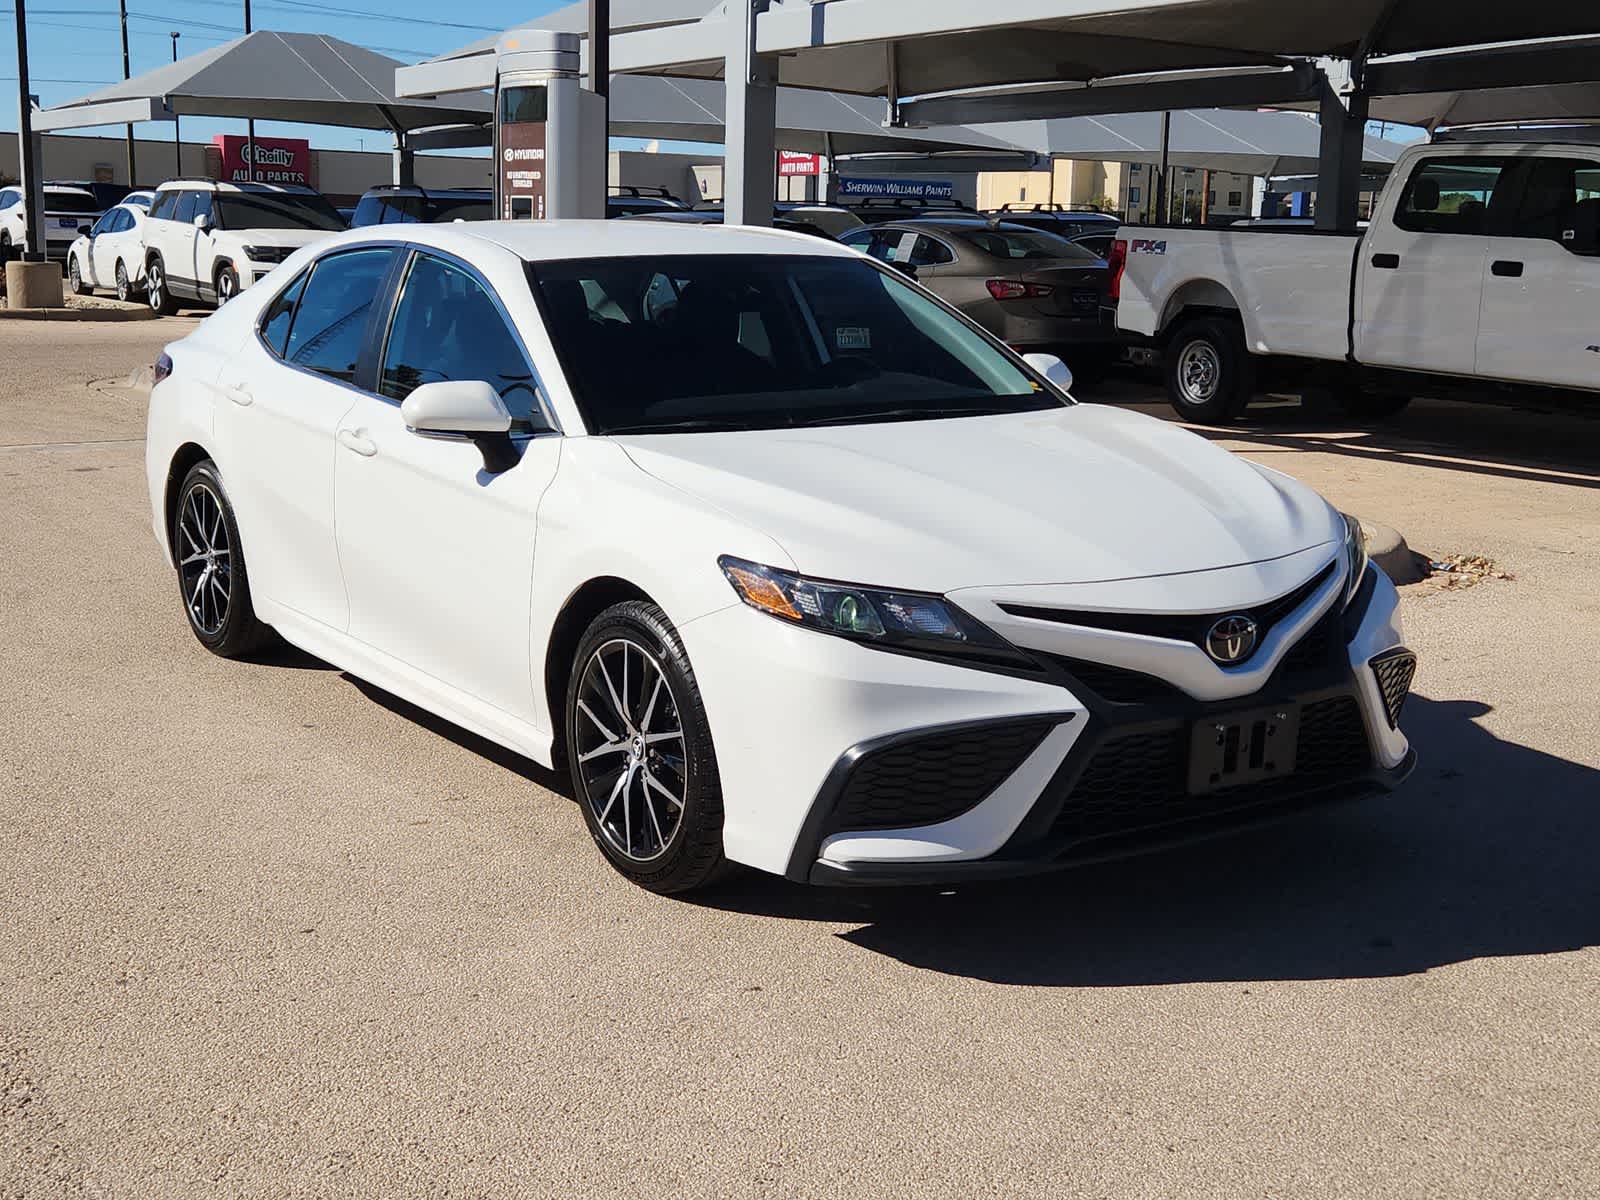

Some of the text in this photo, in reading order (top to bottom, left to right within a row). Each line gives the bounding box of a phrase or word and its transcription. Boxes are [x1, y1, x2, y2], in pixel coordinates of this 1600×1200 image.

[514, 149, 544, 160] HYUNDAI
[796, 162, 814, 173] PARTS
[232, 169, 304, 182] AUO PARTS
[925, 185, 952, 196] PAINTS
[1130, 240, 1167, 252] FX4
